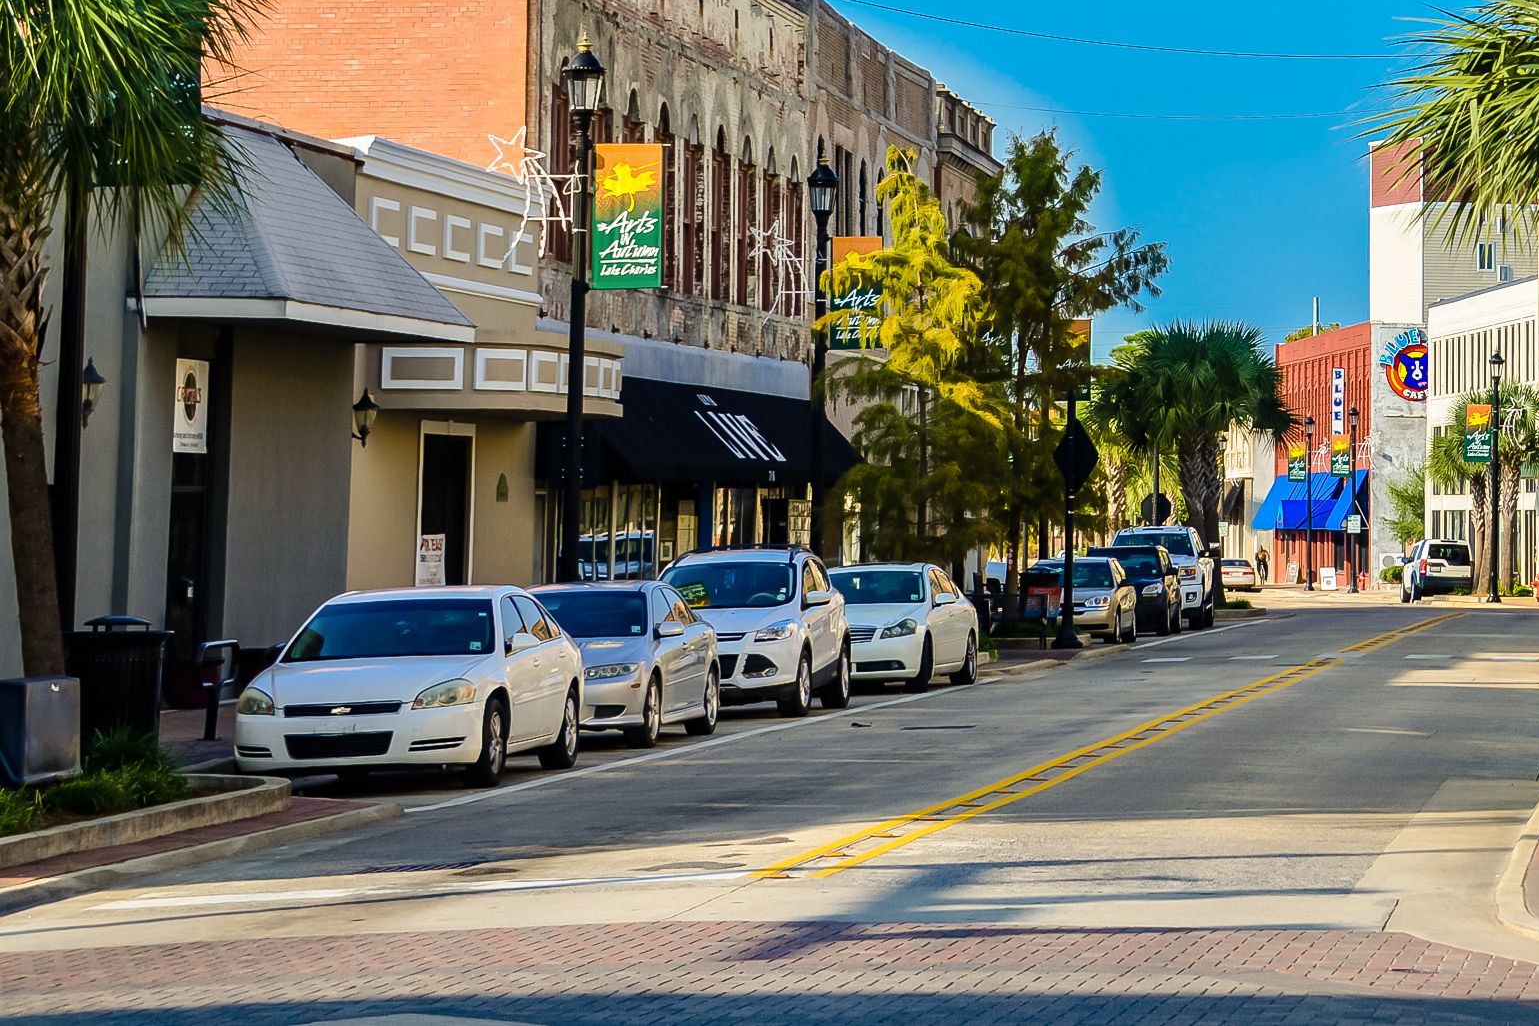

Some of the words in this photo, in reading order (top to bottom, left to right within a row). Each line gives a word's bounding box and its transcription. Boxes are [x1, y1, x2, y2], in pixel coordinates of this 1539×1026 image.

[596, 210, 658, 235] Arts
[599, 239, 660, 259] Autumn
[599, 264, 621, 276] Lake
[621, 263, 658, 276] Charles
[833, 288, 880, 308] Arts
[1378, 328, 1421, 366] BLUE
[693, 410, 787, 462] LIVE
